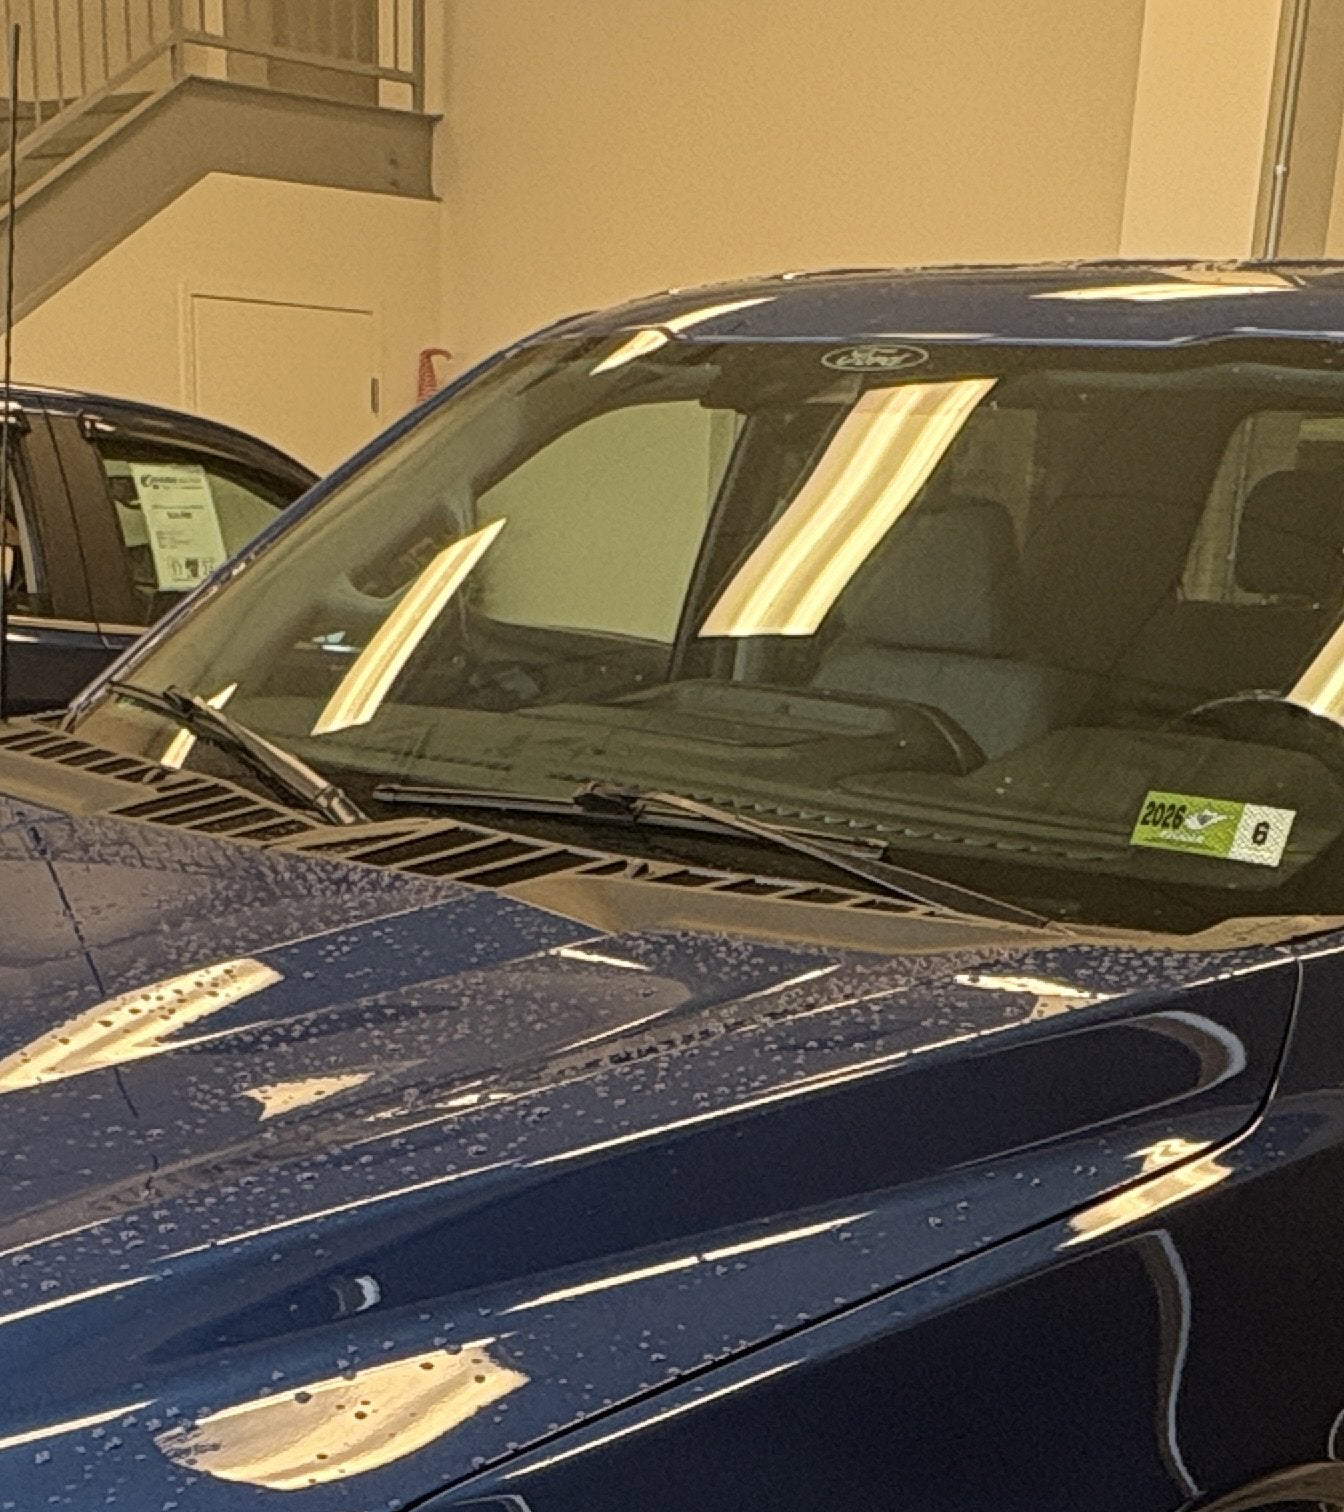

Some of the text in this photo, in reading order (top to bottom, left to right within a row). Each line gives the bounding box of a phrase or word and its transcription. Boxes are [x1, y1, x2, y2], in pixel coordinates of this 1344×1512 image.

[834, 345, 914, 368] Ford
[1141, 801, 1270, 845] 2026 6
